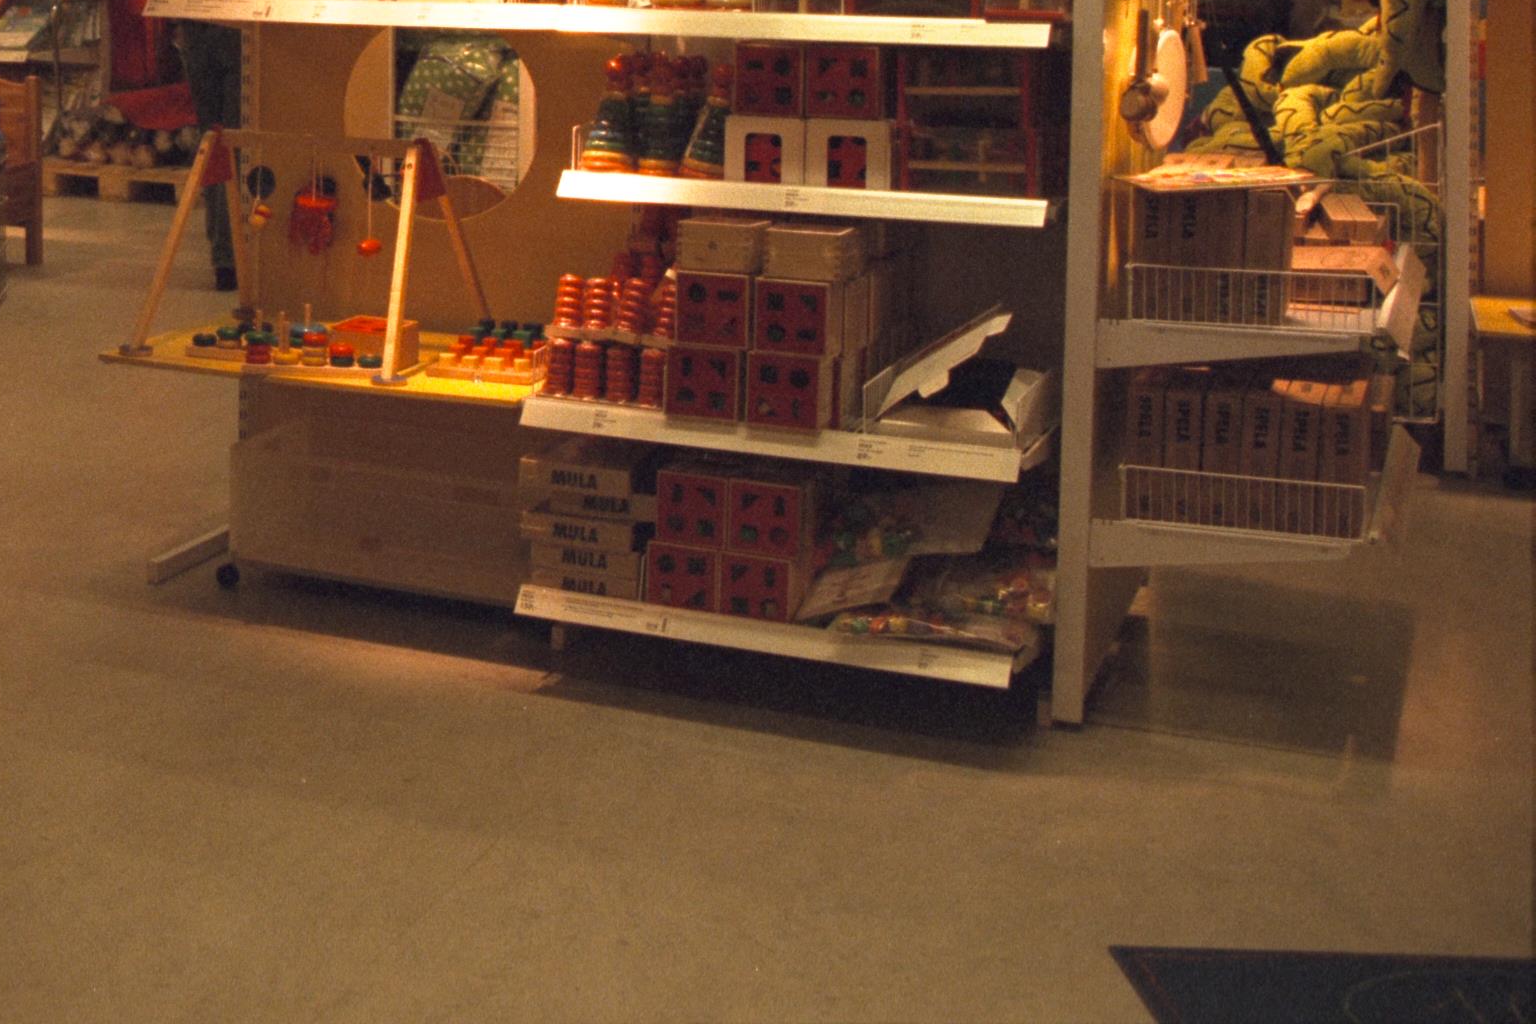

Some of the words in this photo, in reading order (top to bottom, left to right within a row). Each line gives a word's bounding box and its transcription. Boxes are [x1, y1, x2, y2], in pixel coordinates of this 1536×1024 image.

[551, 470, 598, 489] MULA
[583, 495, 631, 513] MULA
[553, 523, 599, 543] MULA
[562, 549, 608, 569] MULA
